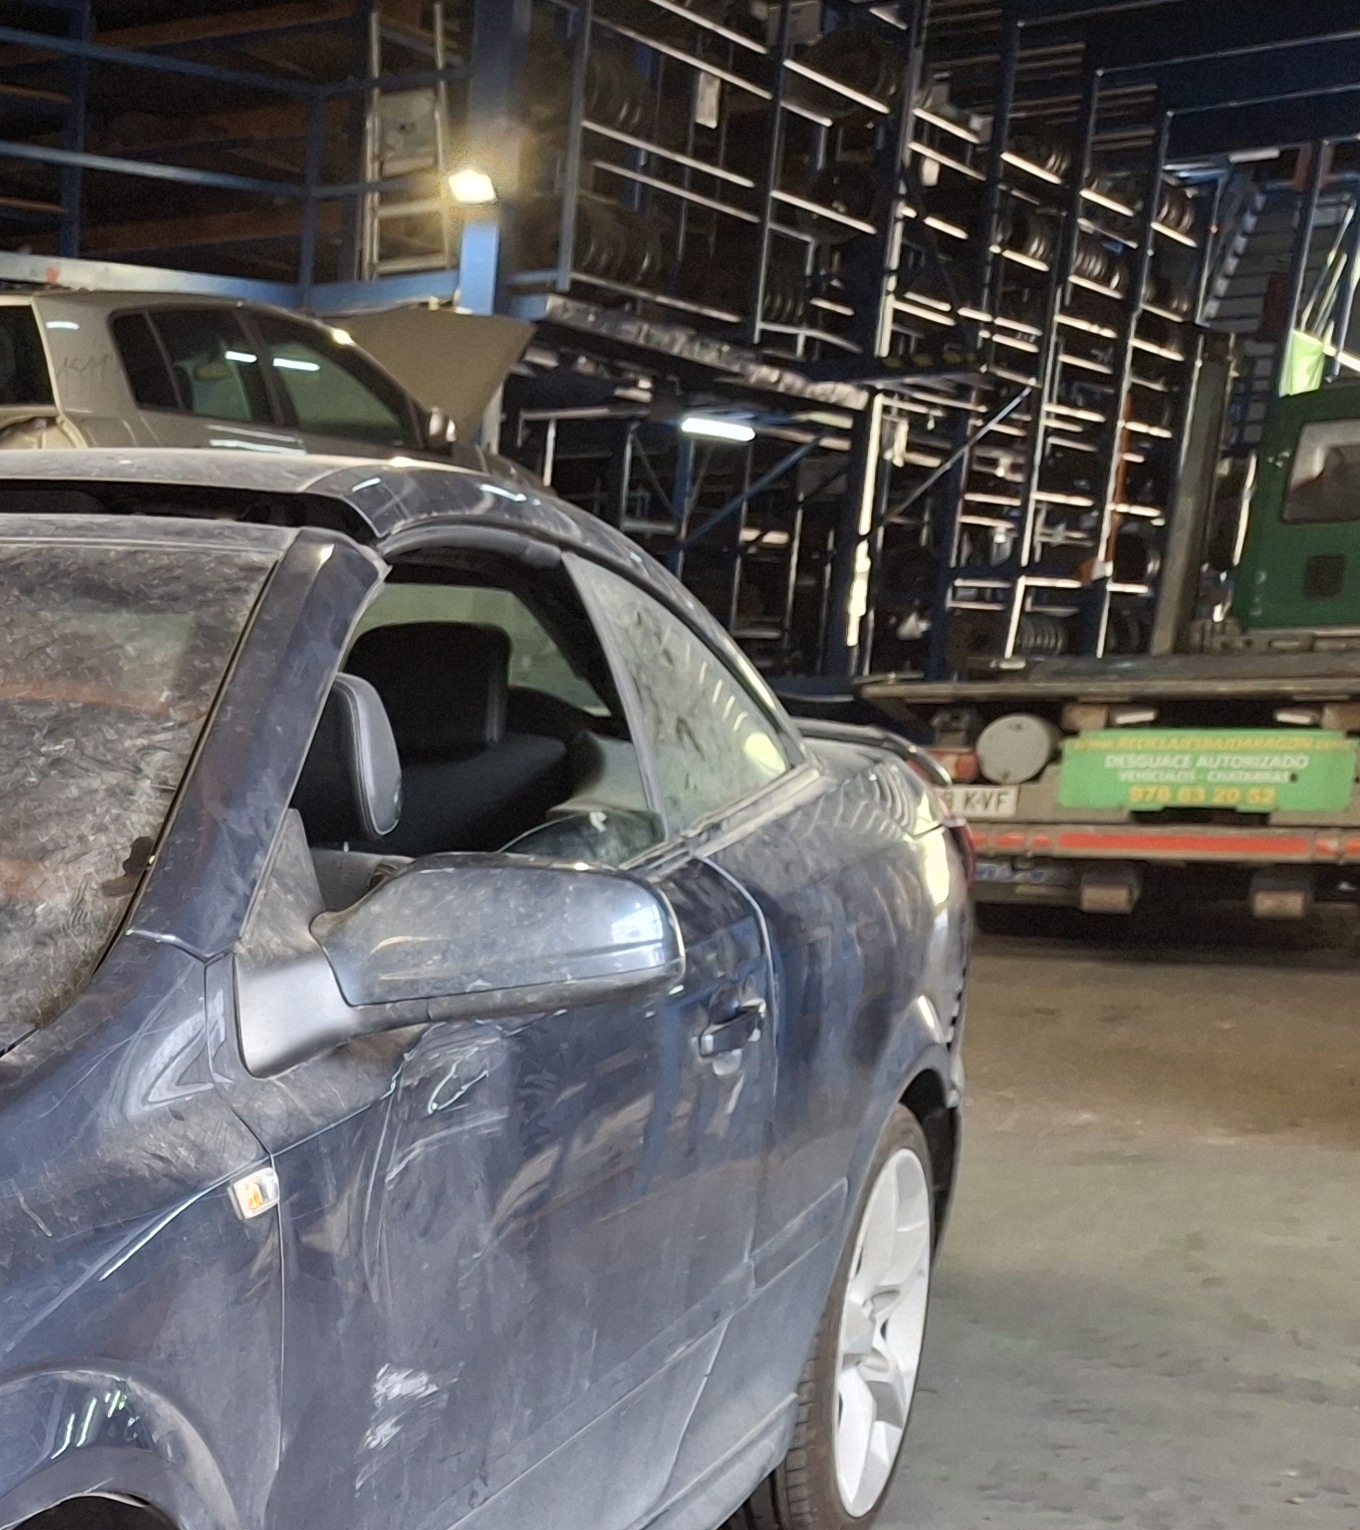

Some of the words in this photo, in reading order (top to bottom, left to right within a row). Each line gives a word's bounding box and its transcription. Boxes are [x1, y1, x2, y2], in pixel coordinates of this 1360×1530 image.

[1104, 754, 1191, 768] DESGUACE
[1196, 754, 1310, 768] AUTORIZADO
[964, 790, 1008, 810] KVF
[1212, 786, 1240, 802] 20
